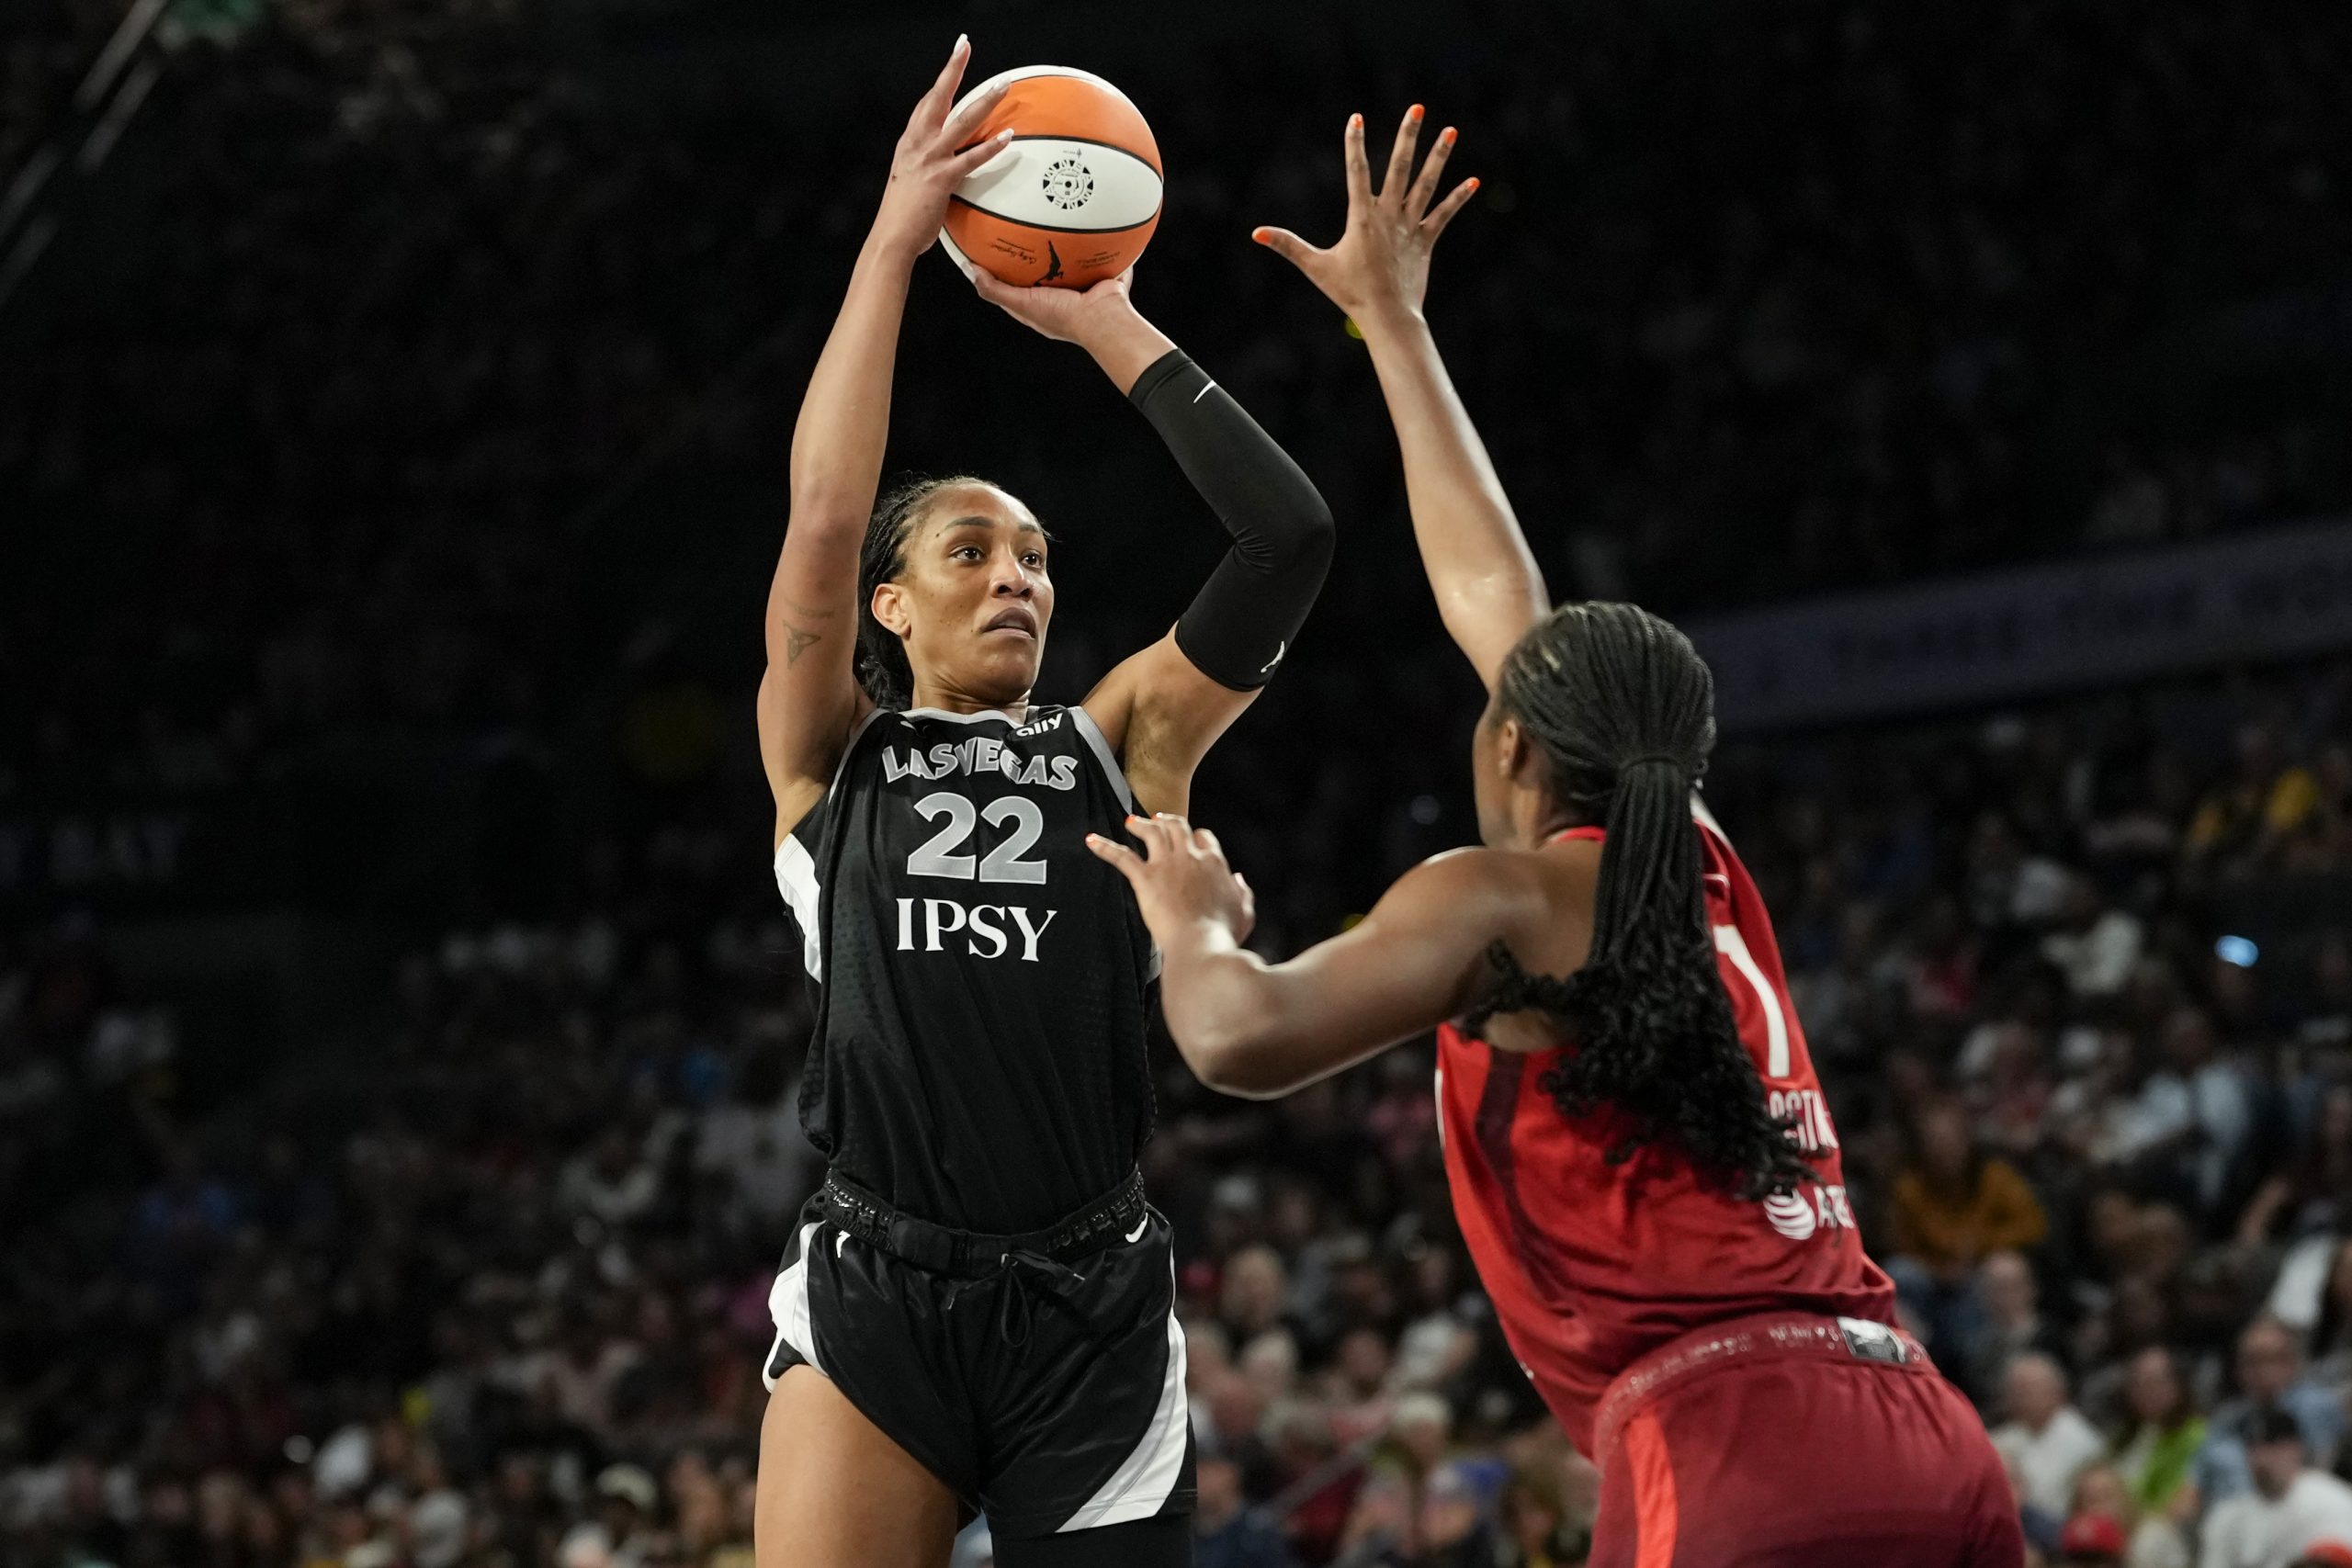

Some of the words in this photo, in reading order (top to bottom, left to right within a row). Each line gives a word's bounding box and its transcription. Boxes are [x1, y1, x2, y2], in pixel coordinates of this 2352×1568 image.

[1016, 712, 1063, 738] ally
[907, 792, 1047, 885] 22
[896, 897, 1057, 962] IPSY
